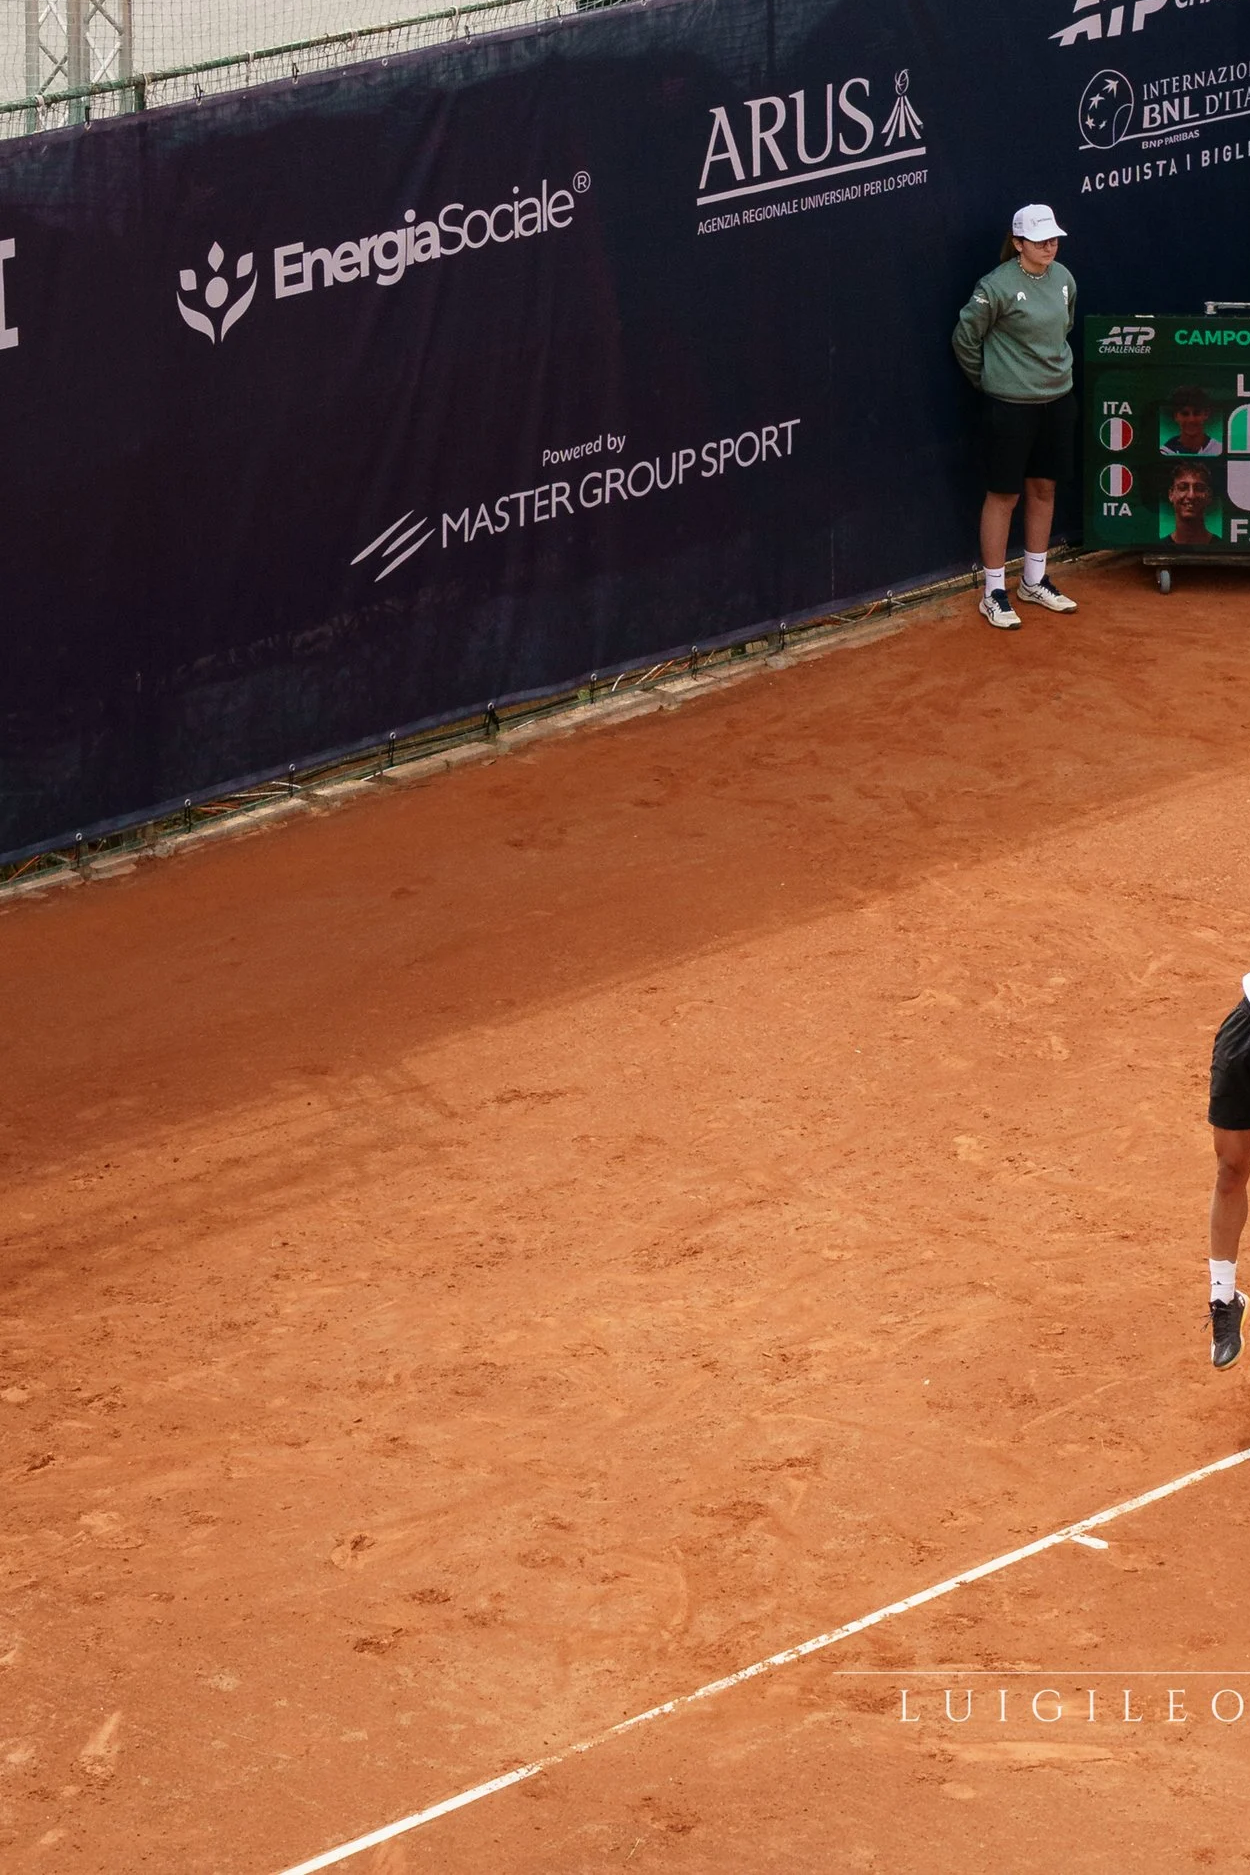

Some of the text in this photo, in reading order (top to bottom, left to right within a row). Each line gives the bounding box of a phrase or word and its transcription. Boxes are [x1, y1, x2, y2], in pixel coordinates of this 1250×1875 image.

[1142, 97, 1200, 129] BNL
[699, 77, 874, 189] ARUS
[1141, 129, 1200, 150] BNP PARIBAS
[1081, 158, 1178, 193] ACQUISTA
[1186, 154, 1191, 171] I
[697, 169, 928, 235] AGENZIA REGIONALE UNIVERSIADI PER LO SPORT
[1096, 326, 1155, 345] ATP
[1098, 345, 1152, 354] CHALLENGER
[1103, 401, 1133, 415] ITA
[542, 432, 626, 467] Powered by
[441, 418, 800, 548] MASTER GROUP SPORT
[1103, 502, 1132, 516] ITA
